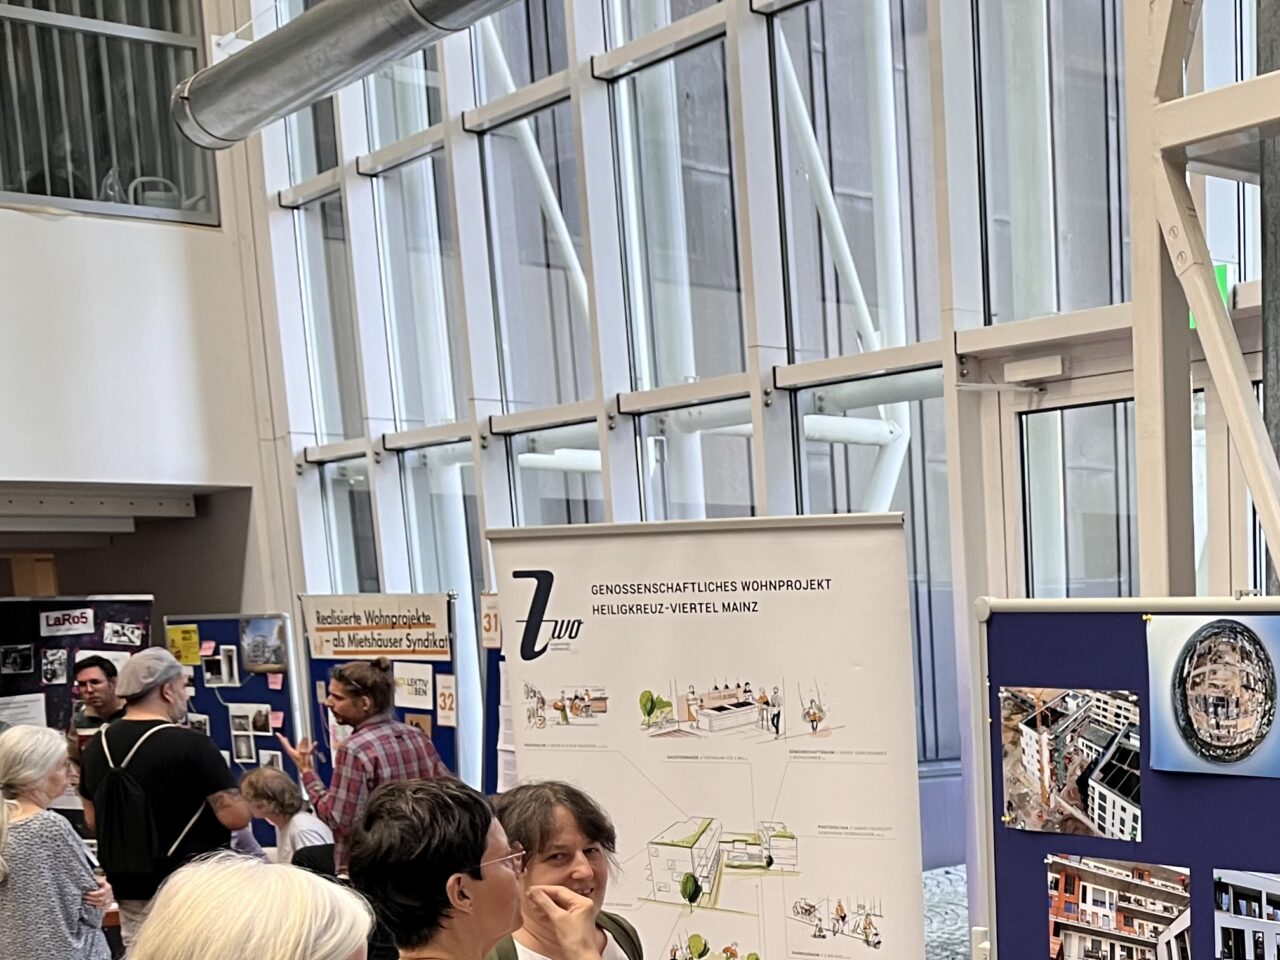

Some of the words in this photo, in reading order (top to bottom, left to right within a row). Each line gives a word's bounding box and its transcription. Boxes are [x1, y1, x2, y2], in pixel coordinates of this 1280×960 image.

[592, 581, 737, 595] GENOSSENSCHAFTLICHES
[741, 578, 832, 592] WOHNPROJEKT
[592, 602, 719, 615] HEILIGKREUZ-VIERTEL
[722, 601, 759, 613] MAINZ
[46, 612, 88, 626] LaRo5
[315, 608, 361, 625] Realisierte
[363, 608, 431, 630] Wohnprojekte
[483, 613, 498, 633] 31
[333, 632, 345, 648] als
[348, 632, 402, 648] Mietshäuser
[406, 632, 448, 653] Syndikat
[439, 692, 455, 711] 32
